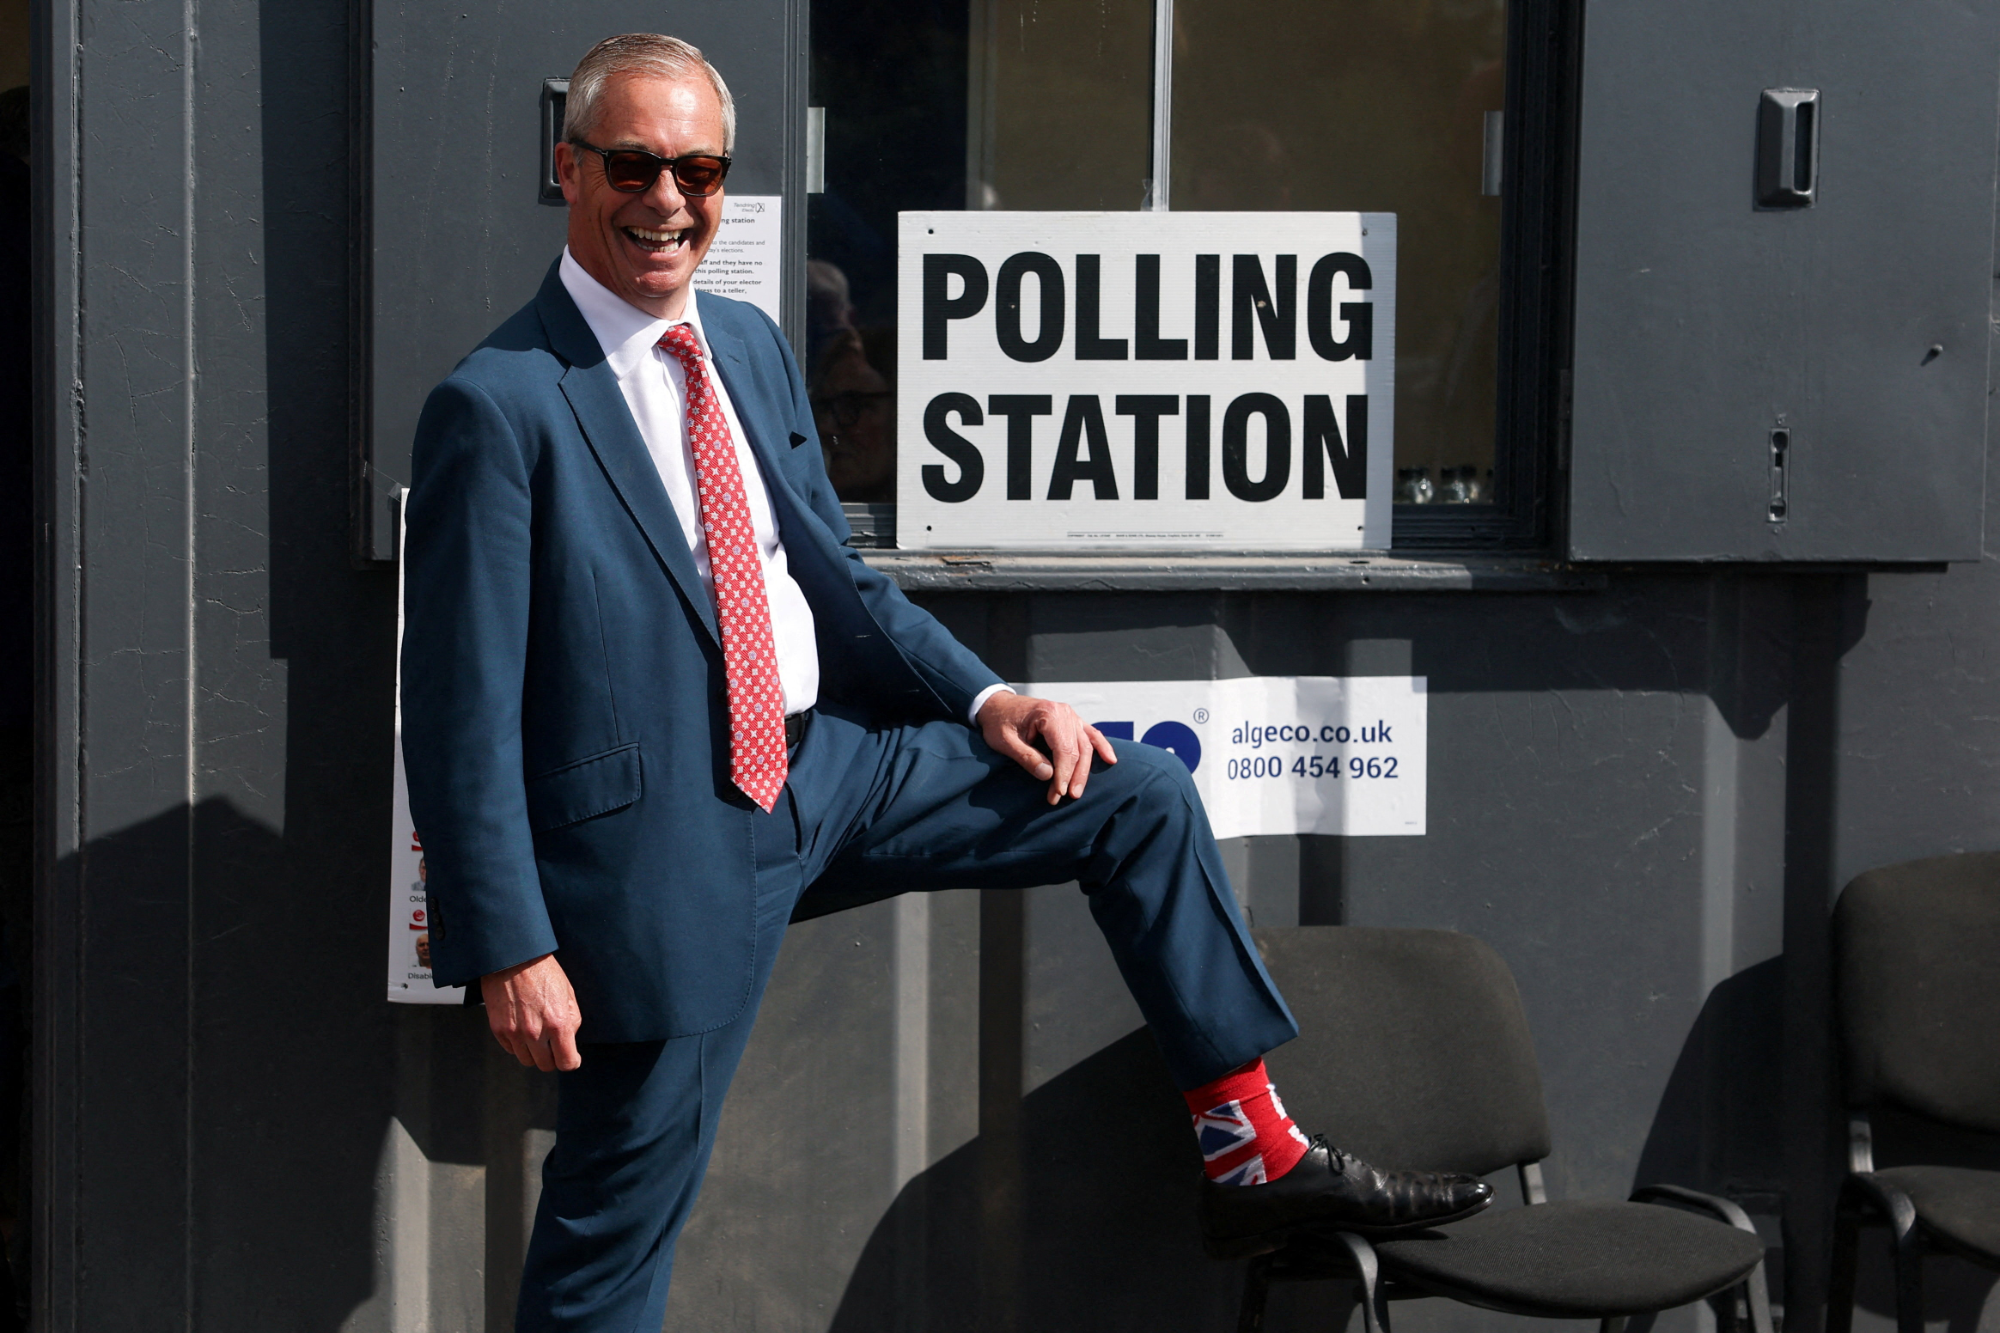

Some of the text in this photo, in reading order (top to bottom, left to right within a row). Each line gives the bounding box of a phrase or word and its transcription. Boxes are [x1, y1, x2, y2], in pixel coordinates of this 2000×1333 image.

[722, 259, 736, 267] they
[922, 251, 1373, 363] POLLING
[921, 392, 1369, 503] STATION
[1232, 720, 1393, 749] algeco.co.uk
[1227, 756, 1399, 780] 0800 454 962
[407, 972, 433, 980] Disabl
